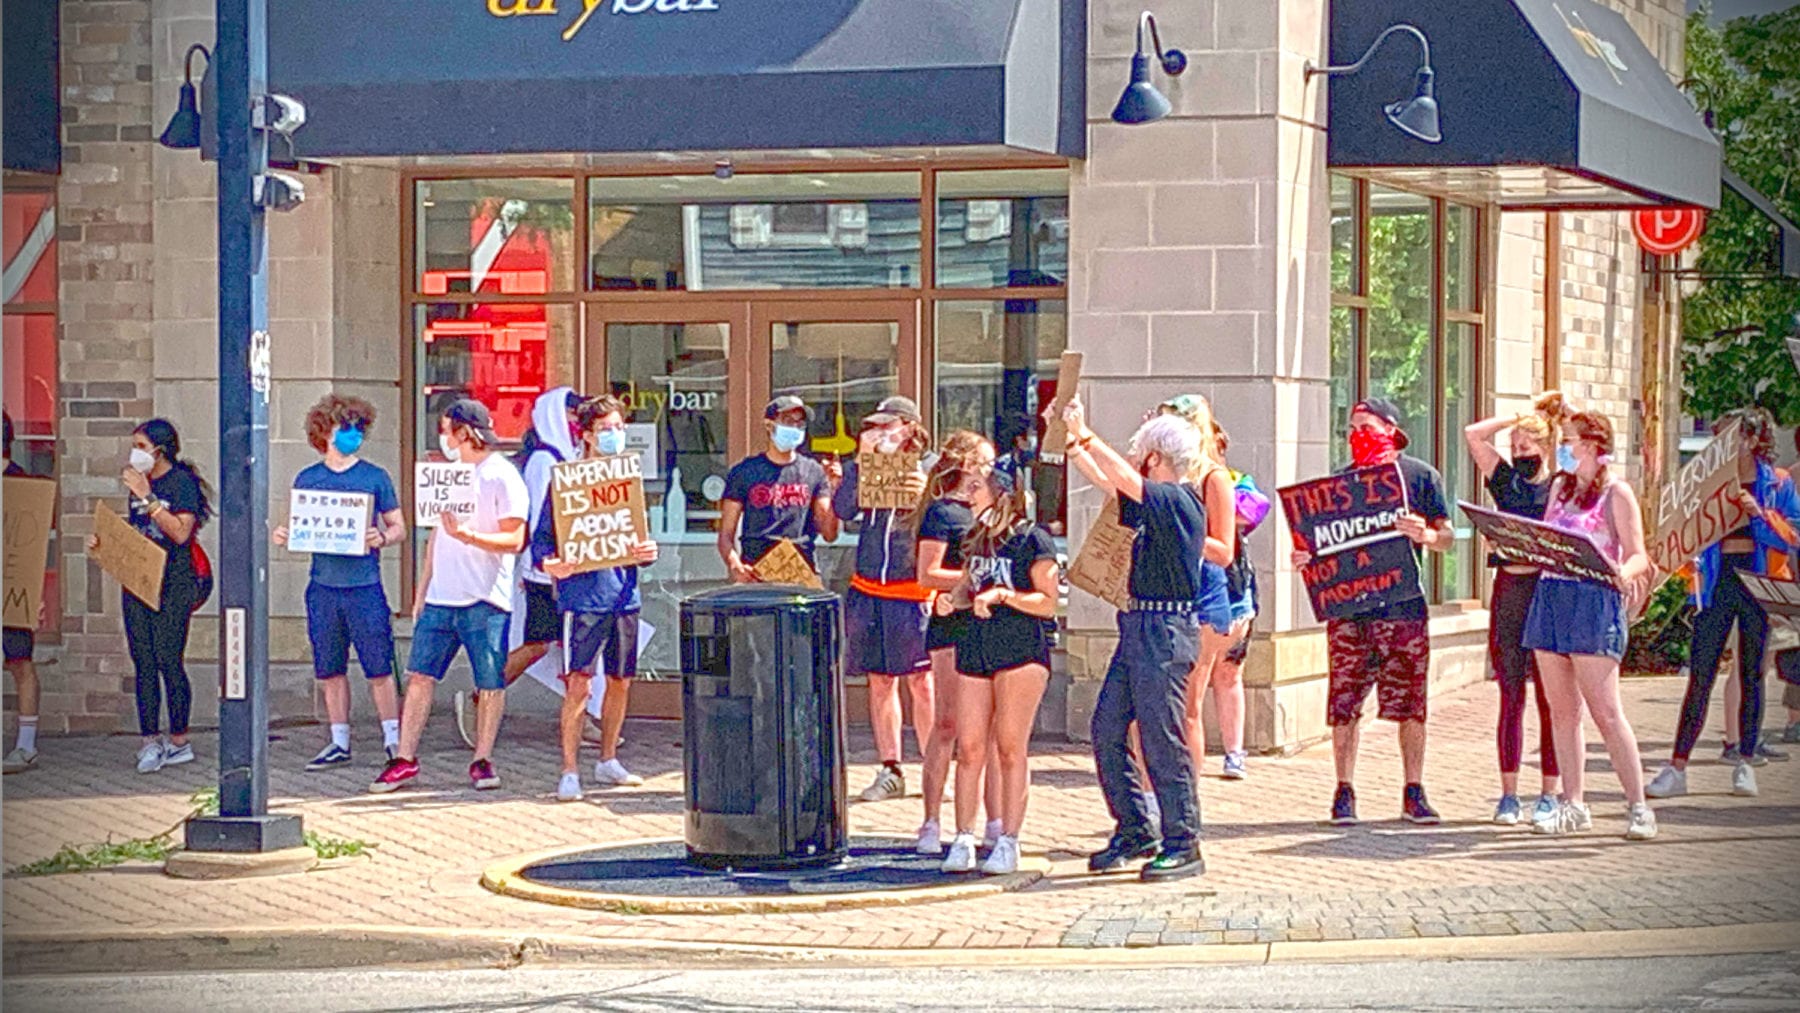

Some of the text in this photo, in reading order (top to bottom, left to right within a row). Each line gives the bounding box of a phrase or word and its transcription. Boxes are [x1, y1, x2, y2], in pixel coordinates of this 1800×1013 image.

[619, 380, 718, 423] drybar
[419, 466, 471, 488] SILENCE
[554, 454, 642, 491] NAPERVILLE
[861, 453, 913, 470] BLACK
[1658, 427, 1739, 526] EVERYONE
[434, 488, 449, 501] IS
[560, 481, 632, 516] IS NOT
[1283, 471, 1401, 525] THIS IS
[569, 508, 634, 540] ABOVE
[564, 532, 639, 564] RACISM
[1302, 550, 1371, 587] NOT A
[1318, 568, 1403, 611] MOMENT
